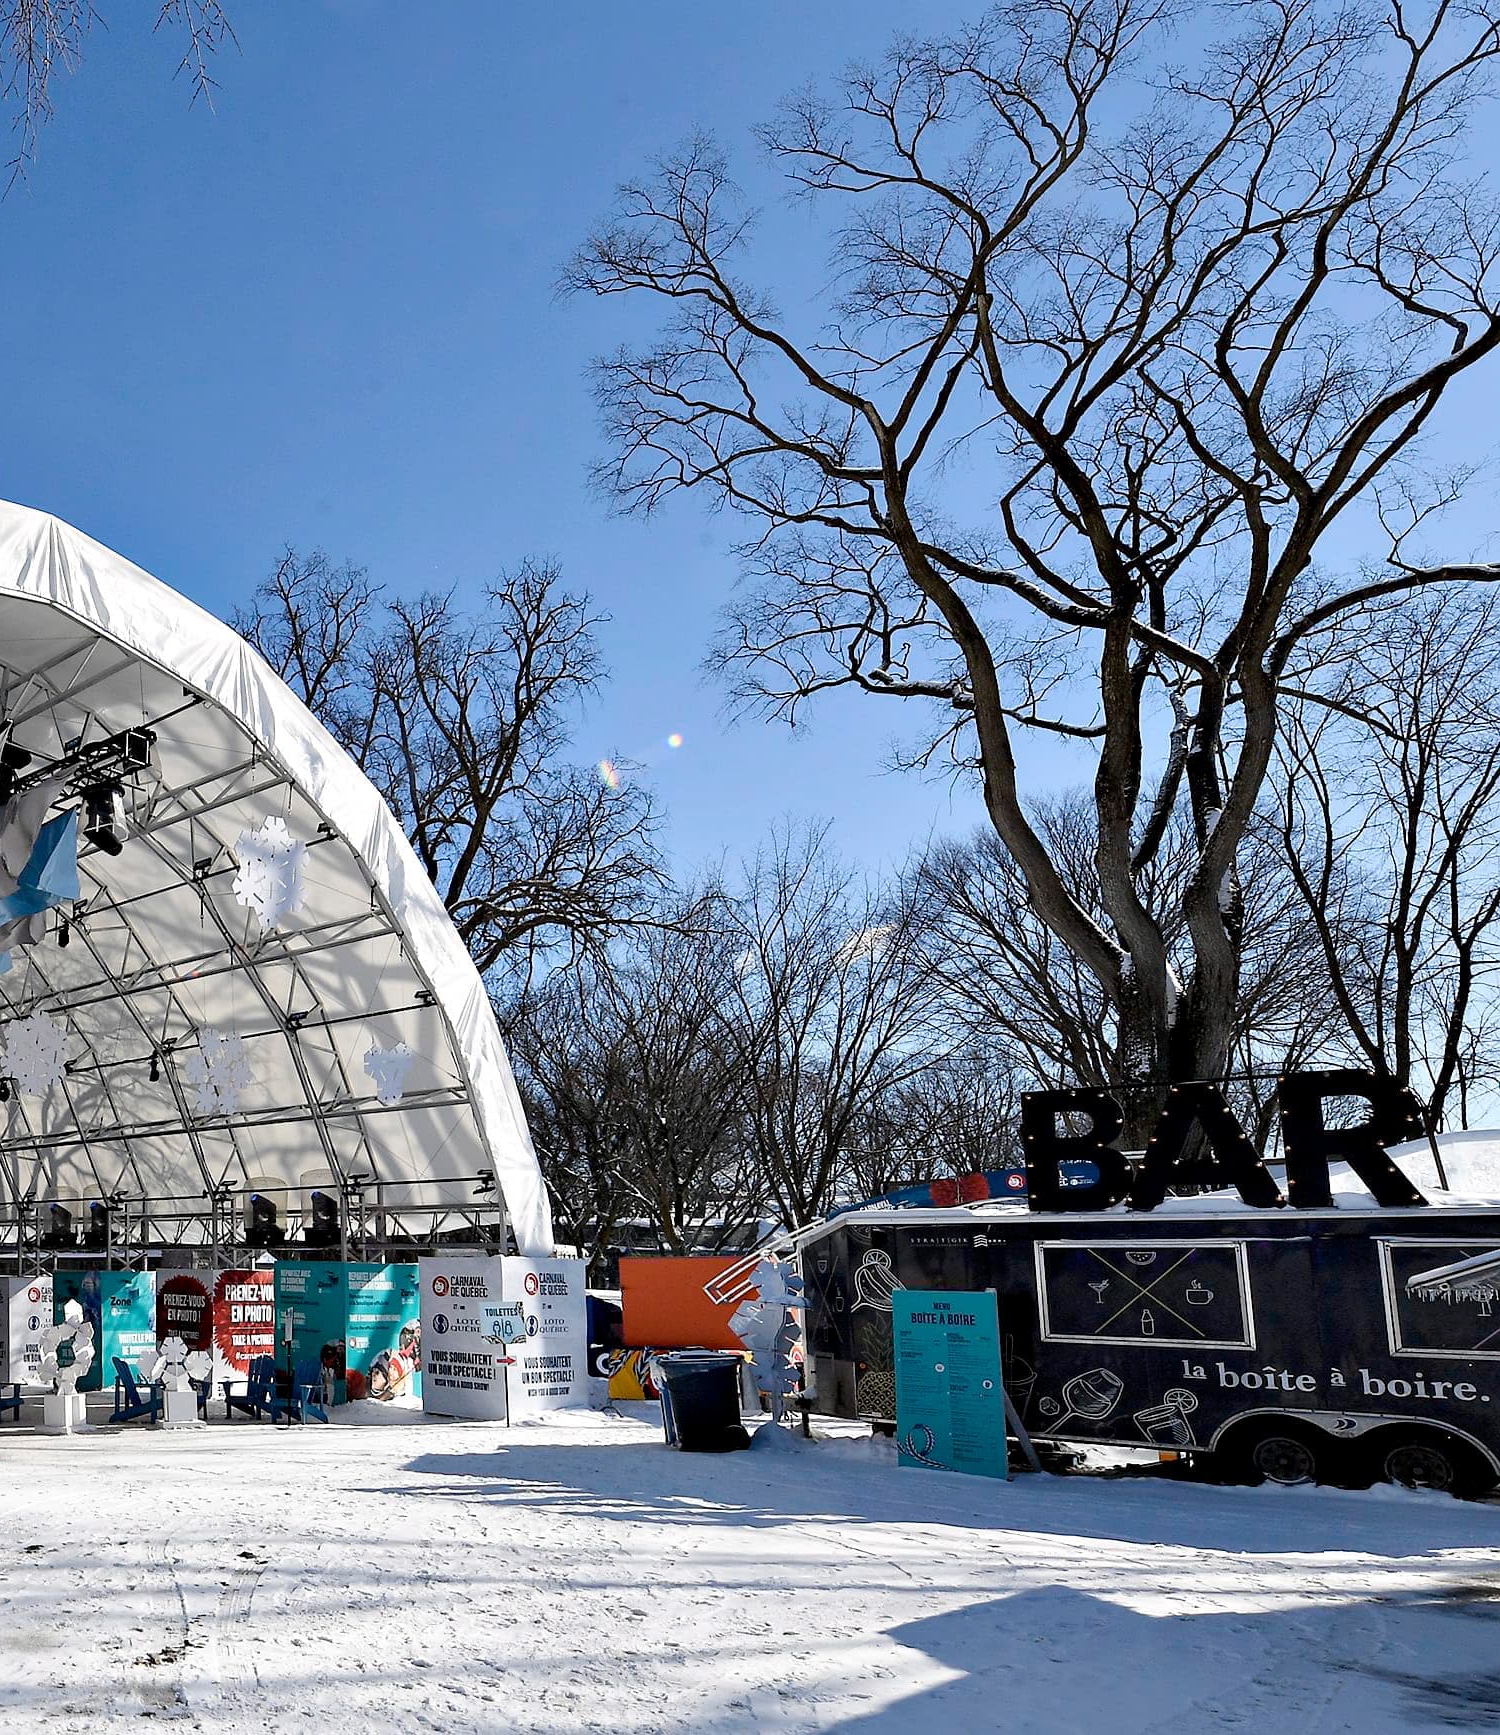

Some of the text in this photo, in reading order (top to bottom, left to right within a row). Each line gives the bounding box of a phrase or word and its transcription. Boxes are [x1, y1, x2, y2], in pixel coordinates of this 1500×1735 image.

[1023, 1068, 1429, 1212] BAR
[450, 1275, 486, 1287] CARNAVAL
[539, 1272, 566, 1284] CARNAVAL
[225, 1284, 275, 1301] PRENEZ-VOU
[450, 1286, 488, 1298] DE QUÉBEC
[110, 1296, 132, 1306] Zone
[163, 1294, 206, 1308] PRENEZ-VOUS
[933, 1301, 951, 1310] MENU
[231, 1305, 272, 1323] EN PHOTO
[484, 1307, 518, 1317] TOILETTES
[948, 1313, 976, 1326] BOIRE
[232, 1334, 247, 1346] TAKE
[430, 1350, 493, 1366] VOUS SOUHAITENT
[523, 1355, 572, 1369] VOUS SOUHAITENT
[428, 1363, 438, 1374] UN
[438, 1364, 452, 1376] BON
[453, 1365, 493, 1380] SPECTACLE
[521, 1372, 530, 1384] UN
[530, 1372, 543, 1384] BON
[543, 1370, 572, 1383] SPECTACLE
[446, 1379, 456, 1388] YOU
[456, 1380, 461, 1388] A
[1182, 1359, 1491, 1402] la boîte à boire.
